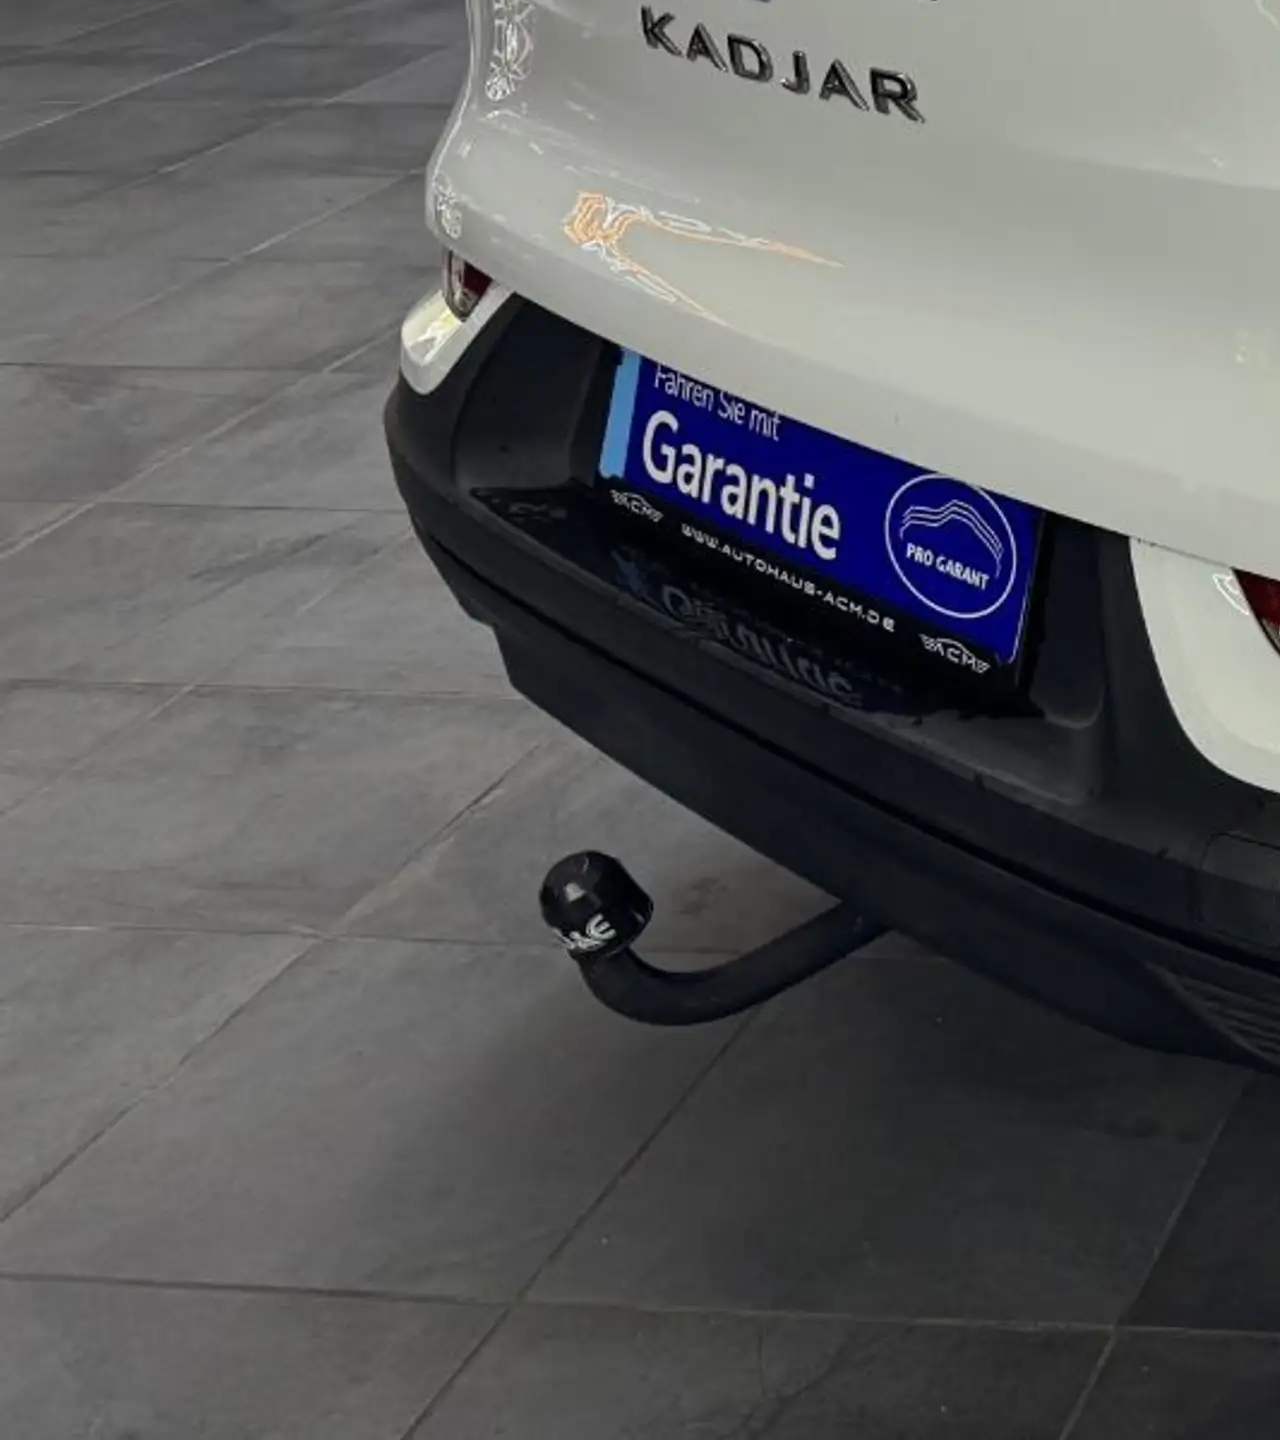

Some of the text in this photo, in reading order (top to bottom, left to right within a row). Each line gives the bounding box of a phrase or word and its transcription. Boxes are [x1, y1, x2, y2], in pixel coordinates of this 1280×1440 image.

[640, 5, 927, 124] KADJAR
[654, 360, 782, 442] Fahren Sie mit
[642, 409, 841, 560] Garantie
[905, 541, 990, 591] PRO GARANT
